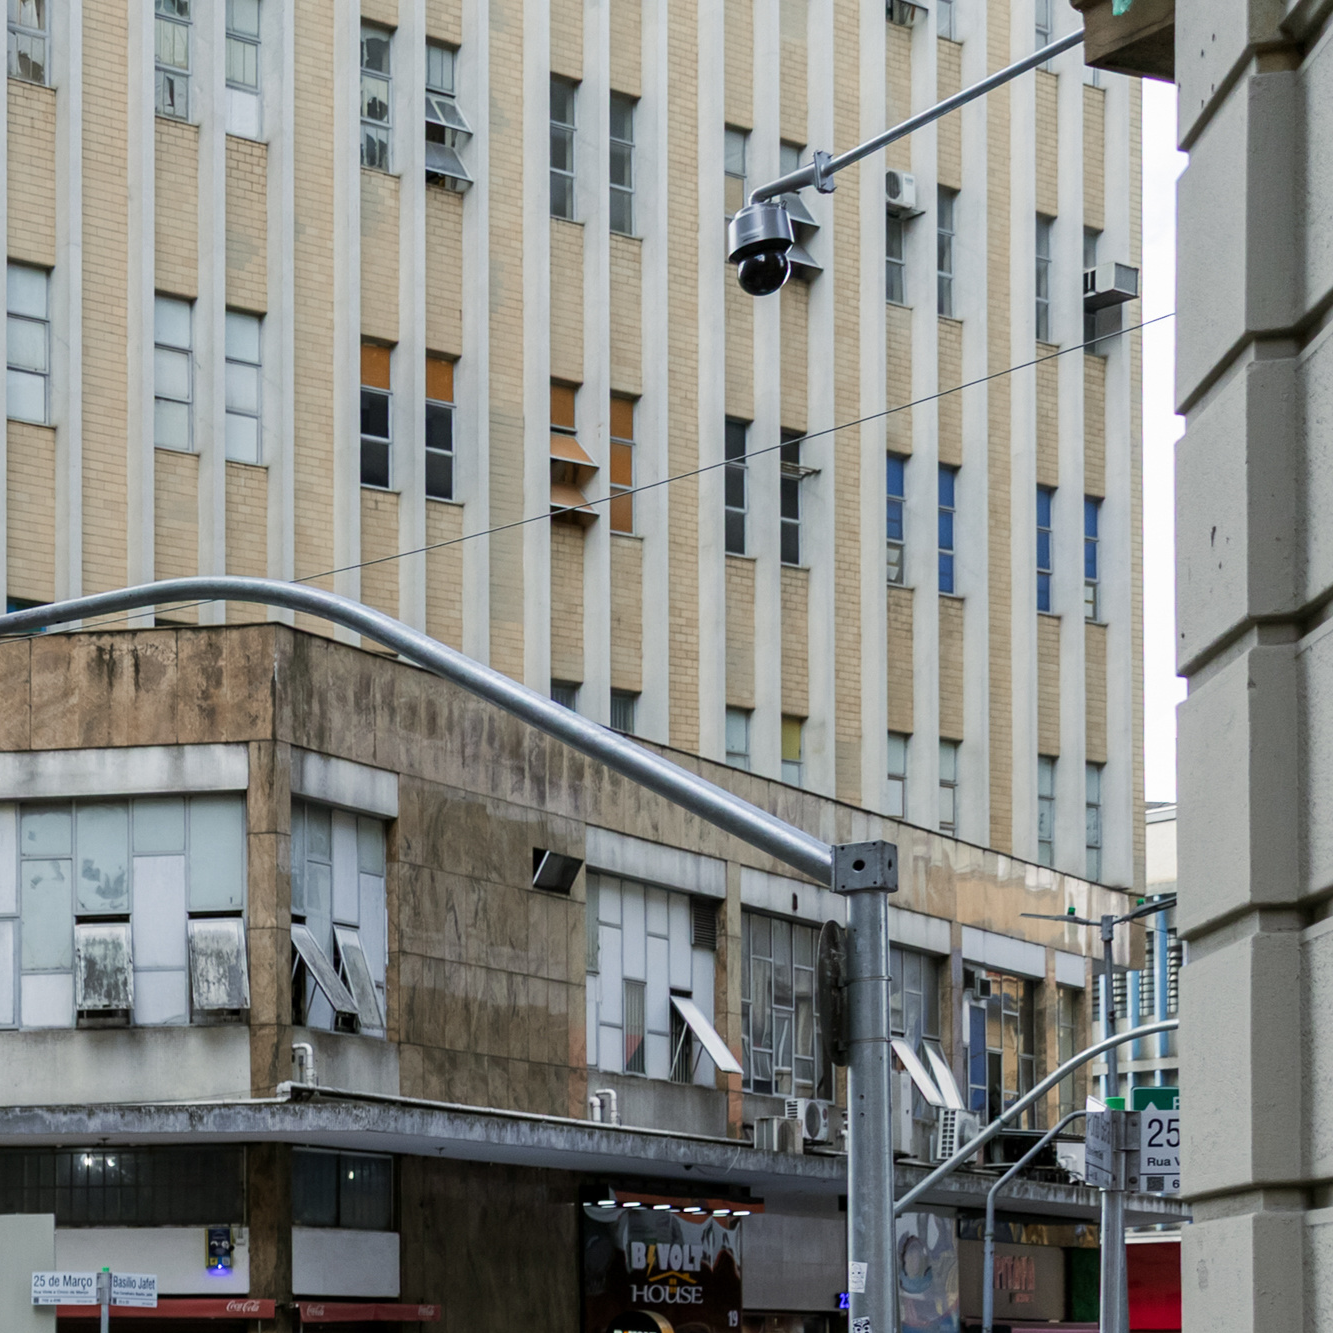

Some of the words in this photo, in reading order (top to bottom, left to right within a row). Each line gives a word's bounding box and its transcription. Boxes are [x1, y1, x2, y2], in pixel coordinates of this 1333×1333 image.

[1147, 1118, 1180, 1148] 25
[1147, 1157, 1172, 1167] Rua
[33, 1275, 46, 1287] 25
[48, 1275, 60, 1287] de
[62, 1275, 93, 1290] Março
[138, 1277, 155, 1290] Jafet
[630, 1284, 704, 1304] HOUSE
[226, 1300, 260, 1313] Coca-Cola
[728, 1310, 738, 1327] 19
